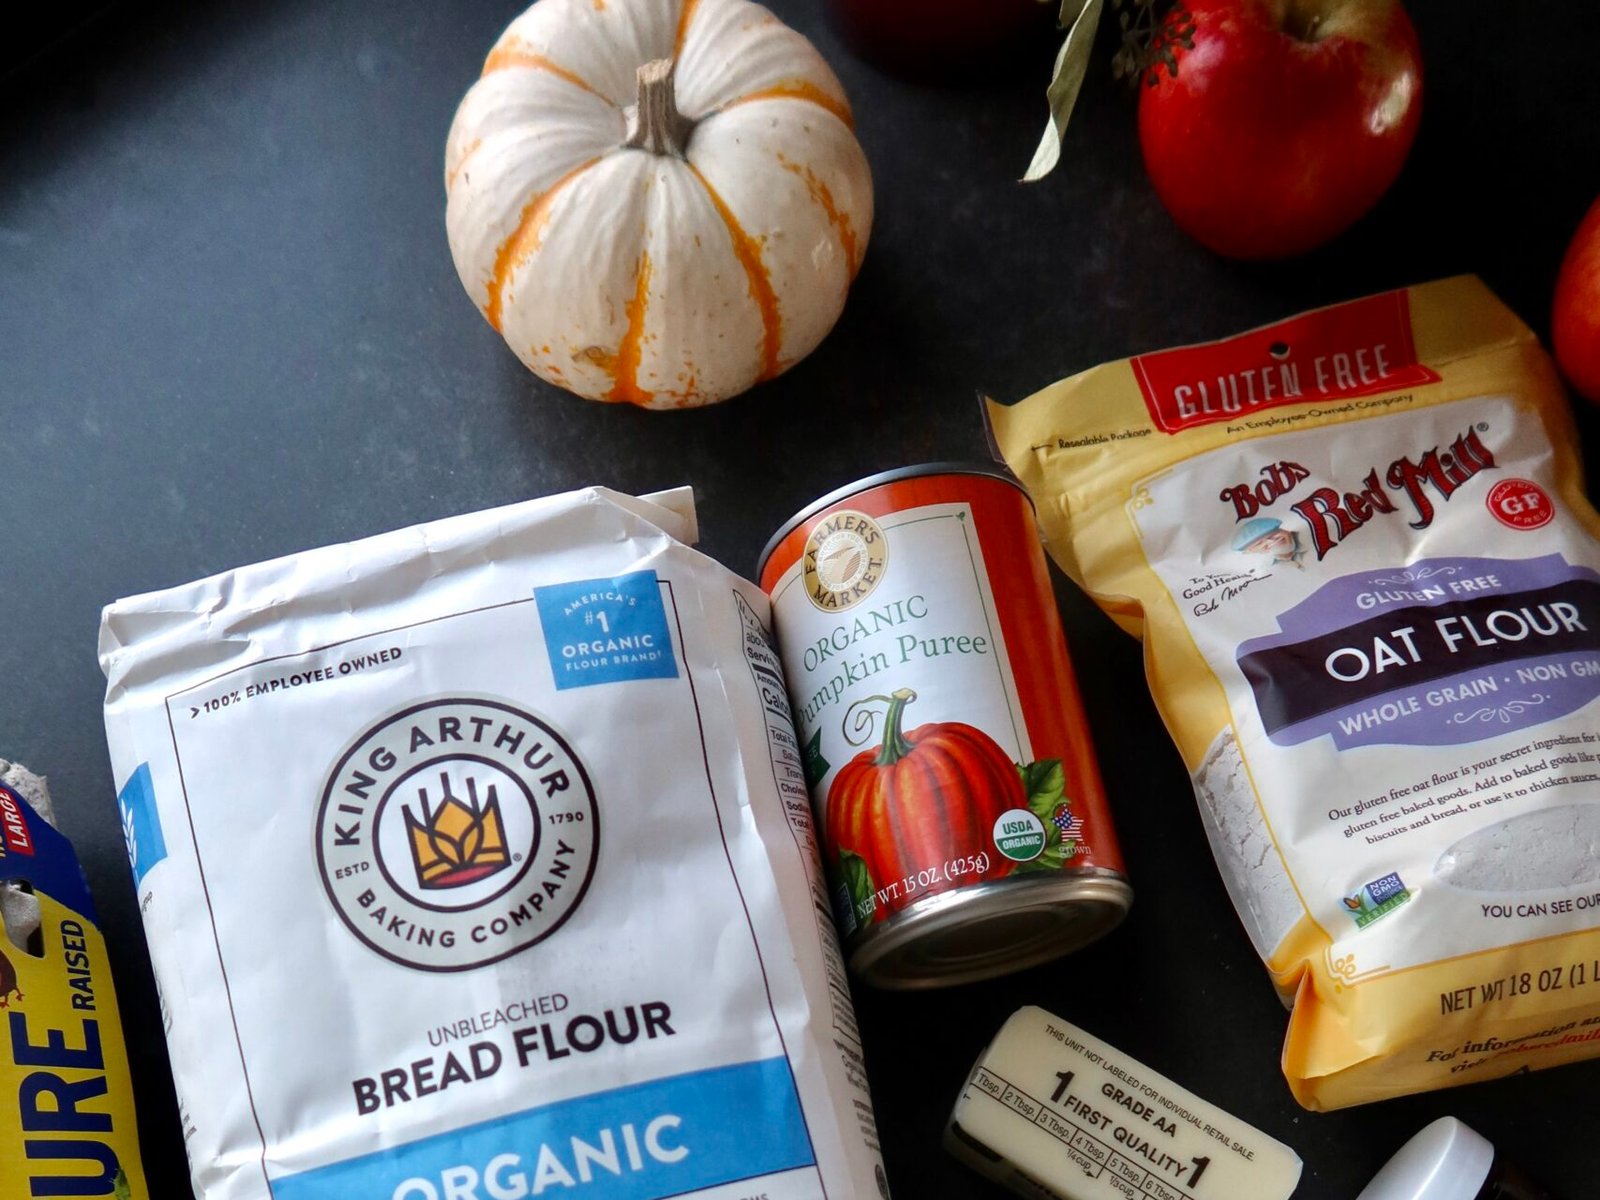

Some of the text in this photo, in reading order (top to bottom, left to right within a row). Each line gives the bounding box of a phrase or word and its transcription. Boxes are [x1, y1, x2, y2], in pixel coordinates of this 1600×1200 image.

[1174, 344, 1390, 419] GLUTEN FREE
[1058, 427, 1152, 450] Resealable Package
[1290, 424, 1499, 562] Red Mill
[1501, 491, 1540, 516] GF
[563, 592, 638, 616] AMERICA'S
[1356, 574, 1502, 610] GLUTEN FREE
[562, 634, 654, 658] ORGANIC
[584, 610, 609, 633] #1
[803, 595, 928, 672] ORGANIC
[1325, 602, 1588, 682] OAT FLOUR
[565, 657, 608, 672] FLOUR
[896, 634, 987, 663] Puree
[203, 646, 402, 713] 100% EMPLOYEE OWNED
[1337, 663, 1568, 736] WHOLE GRAIN NON
[334, 716, 570, 846] KING ARTHUR
[1328, 731, 1596, 821] Our gluten free oat flour is your secret ingredient for
[1, 791, 28, 848] LARGE
[548, 811, 584, 825] 1790
[1002, 819, 1034, 834] USDA
[1002, 836, 1041, 850] ORGANIC
[335, 861, 370, 879] ESTD
[1058, 842, 1091, 857] grown
[357, 840, 575, 947] BAKING COMPANY
[856, 893, 876, 919] NET
[876, 883, 901, 905] WT.
[902, 874, 917, 893] 15
[918, 866, 943, 887] OZ.
[944, 851, 990, 881] (425g)
[1481, 899, 1573, 918] YOU CAN SEE
[61, 919, 96, 1011] RAISED
[1440, 967, 1562, 1015] NET WT 18 OZ
[427, 993, 569, 1047] UNBLEACHED
[352, 1001, 676, 1116] BREAD FLOUR
[1045, 1024, 1256, 1162] THIS UNIT NOT LABELED FOR INDIVIDUAL RETAIL SALE.
[1050, 1070, 1075, 1103] 1
[1101, 1082, 1177, 1138] GRADE AA
[1063, 1094, 1188, 1178] FIRST QUALITY
[1186, 1155, 1211, 1189] 1
